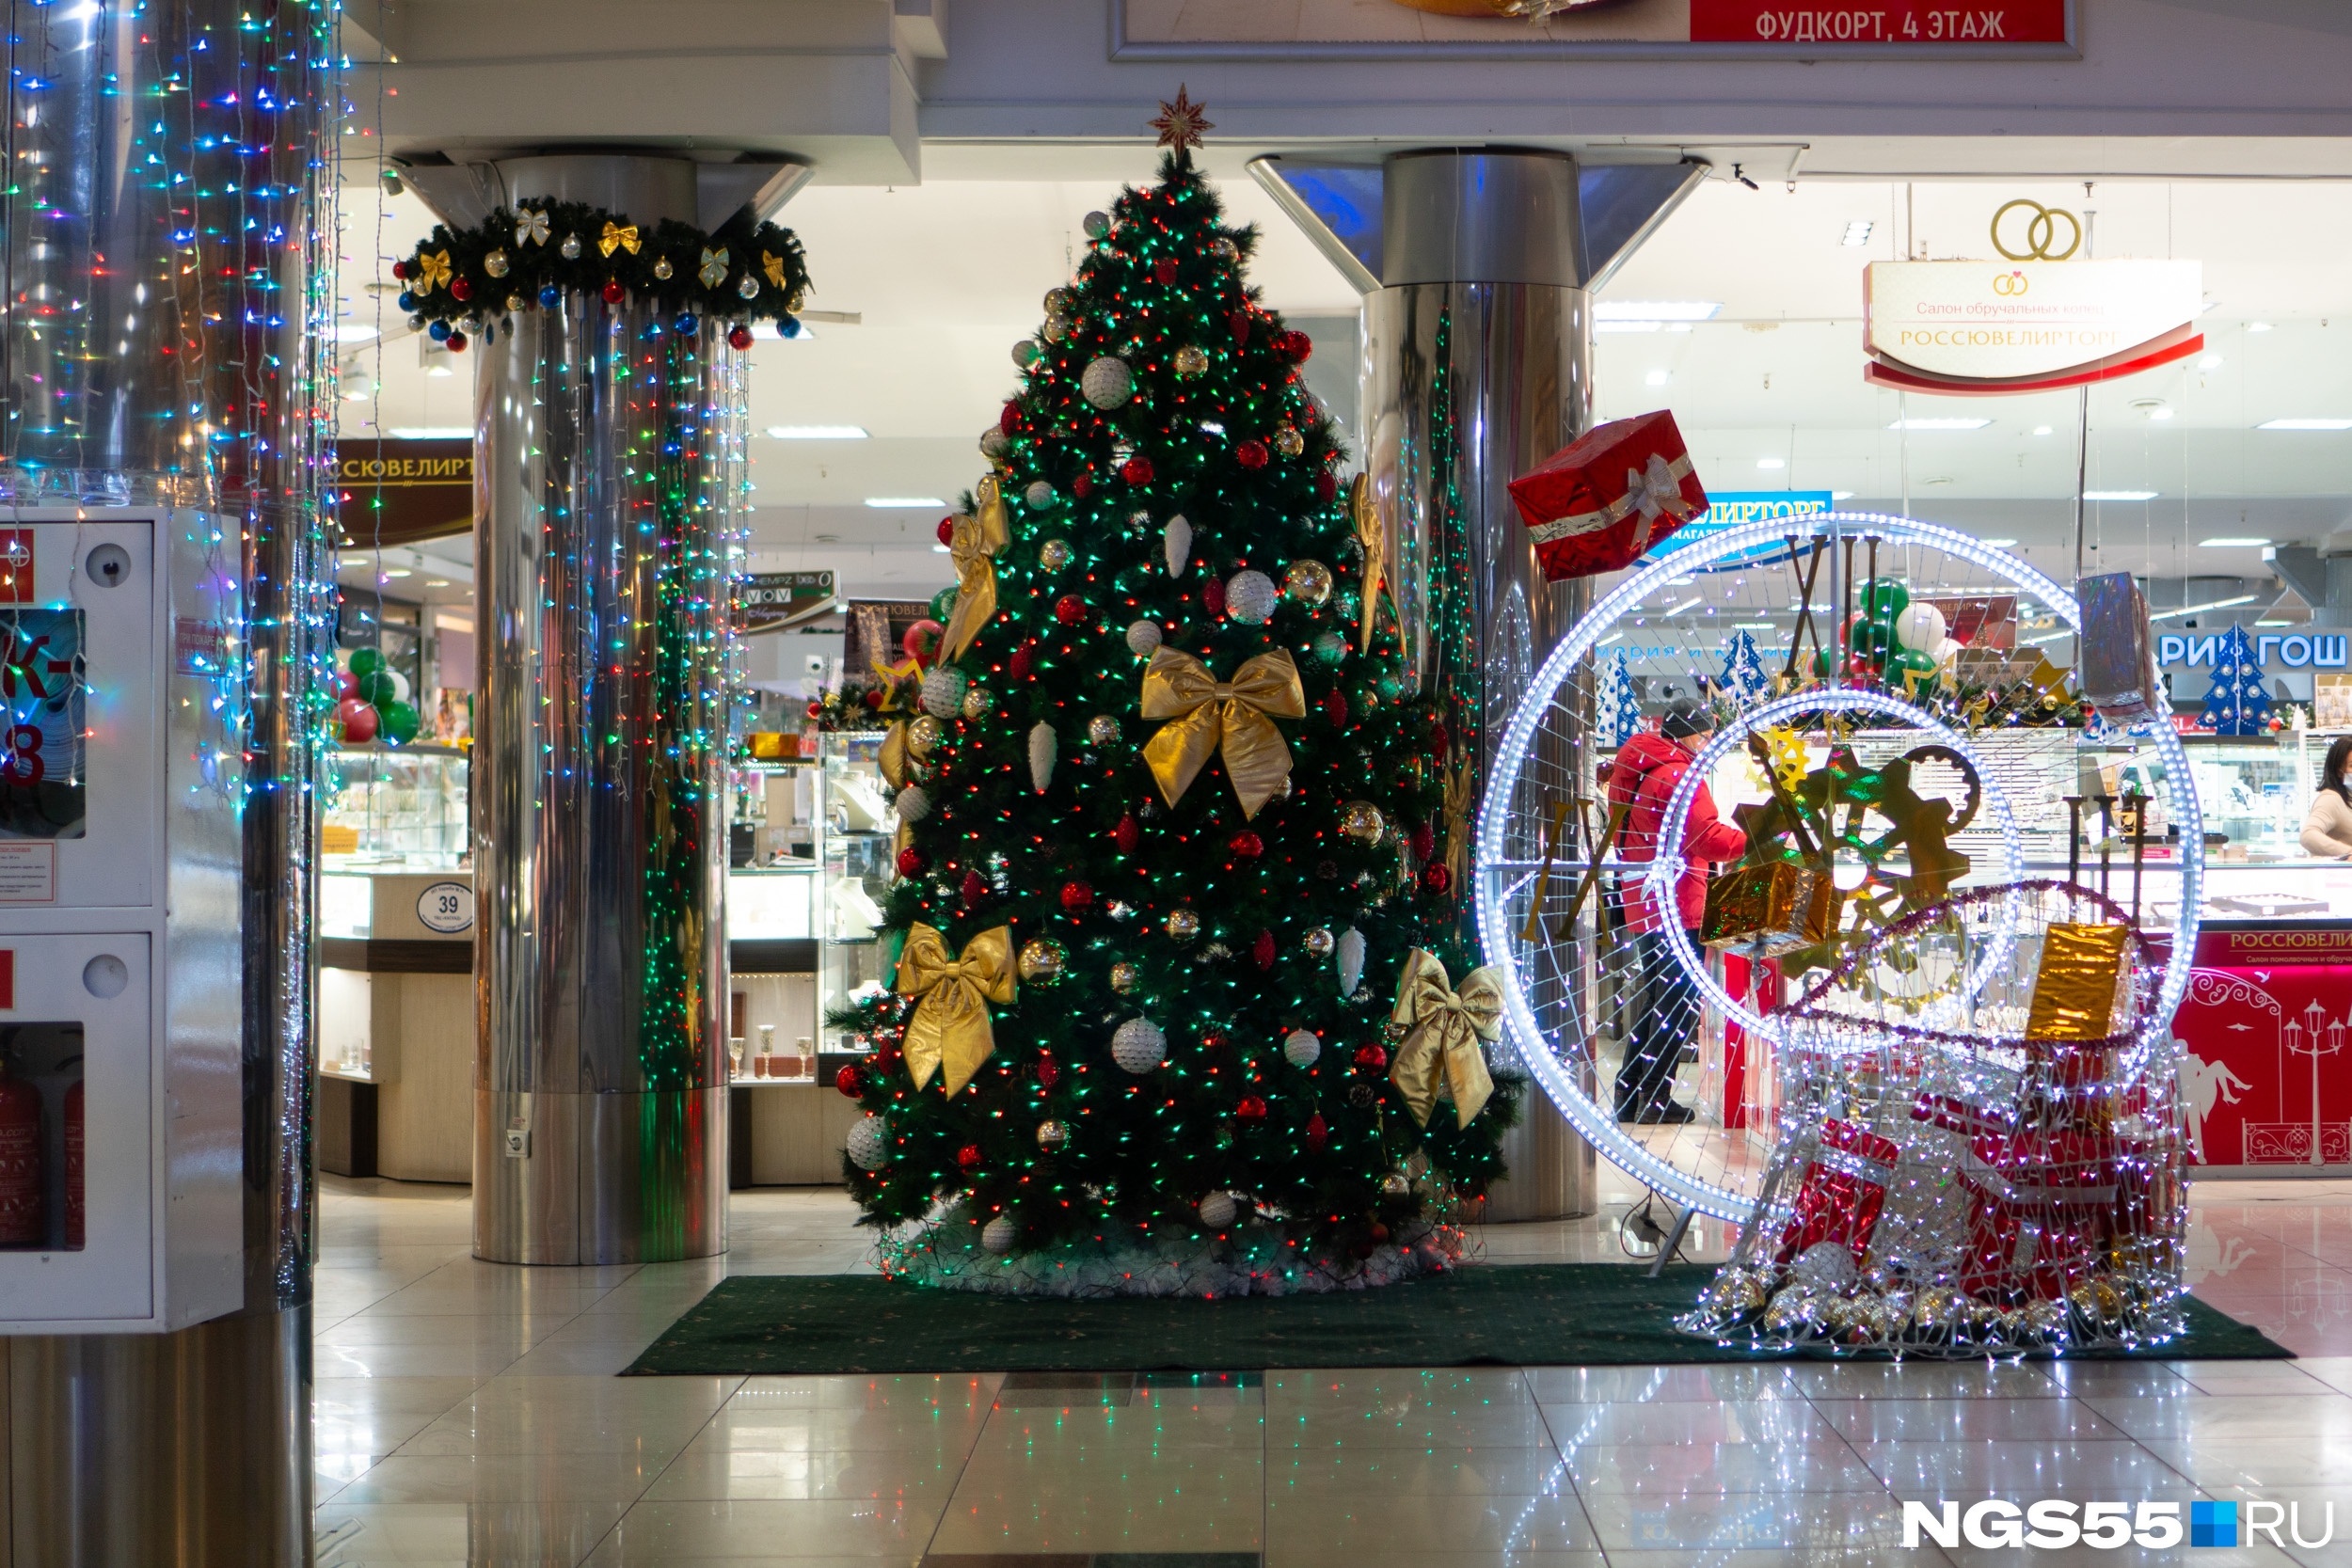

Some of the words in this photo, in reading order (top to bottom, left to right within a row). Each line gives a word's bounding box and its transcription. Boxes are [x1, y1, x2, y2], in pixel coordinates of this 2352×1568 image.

[1756, 10, 1893, 41] ФУДКОРТ,
[1902, 11, 1919, 39] 4
[1927, 11, 2005, 39] ЭТАЖ
[1916, 302, 1962, 315] Салон
[1965, 301, 2058, 318] обручальных
[1900, 330, 2118, 346] РОССЮВЕЛИРТОРГ
[2257, 635, 2347, 667] ГОШ
[438, 895, 458, 913] 39
[2231, 933, 2352, 947] РОССЮВЕЛИ
